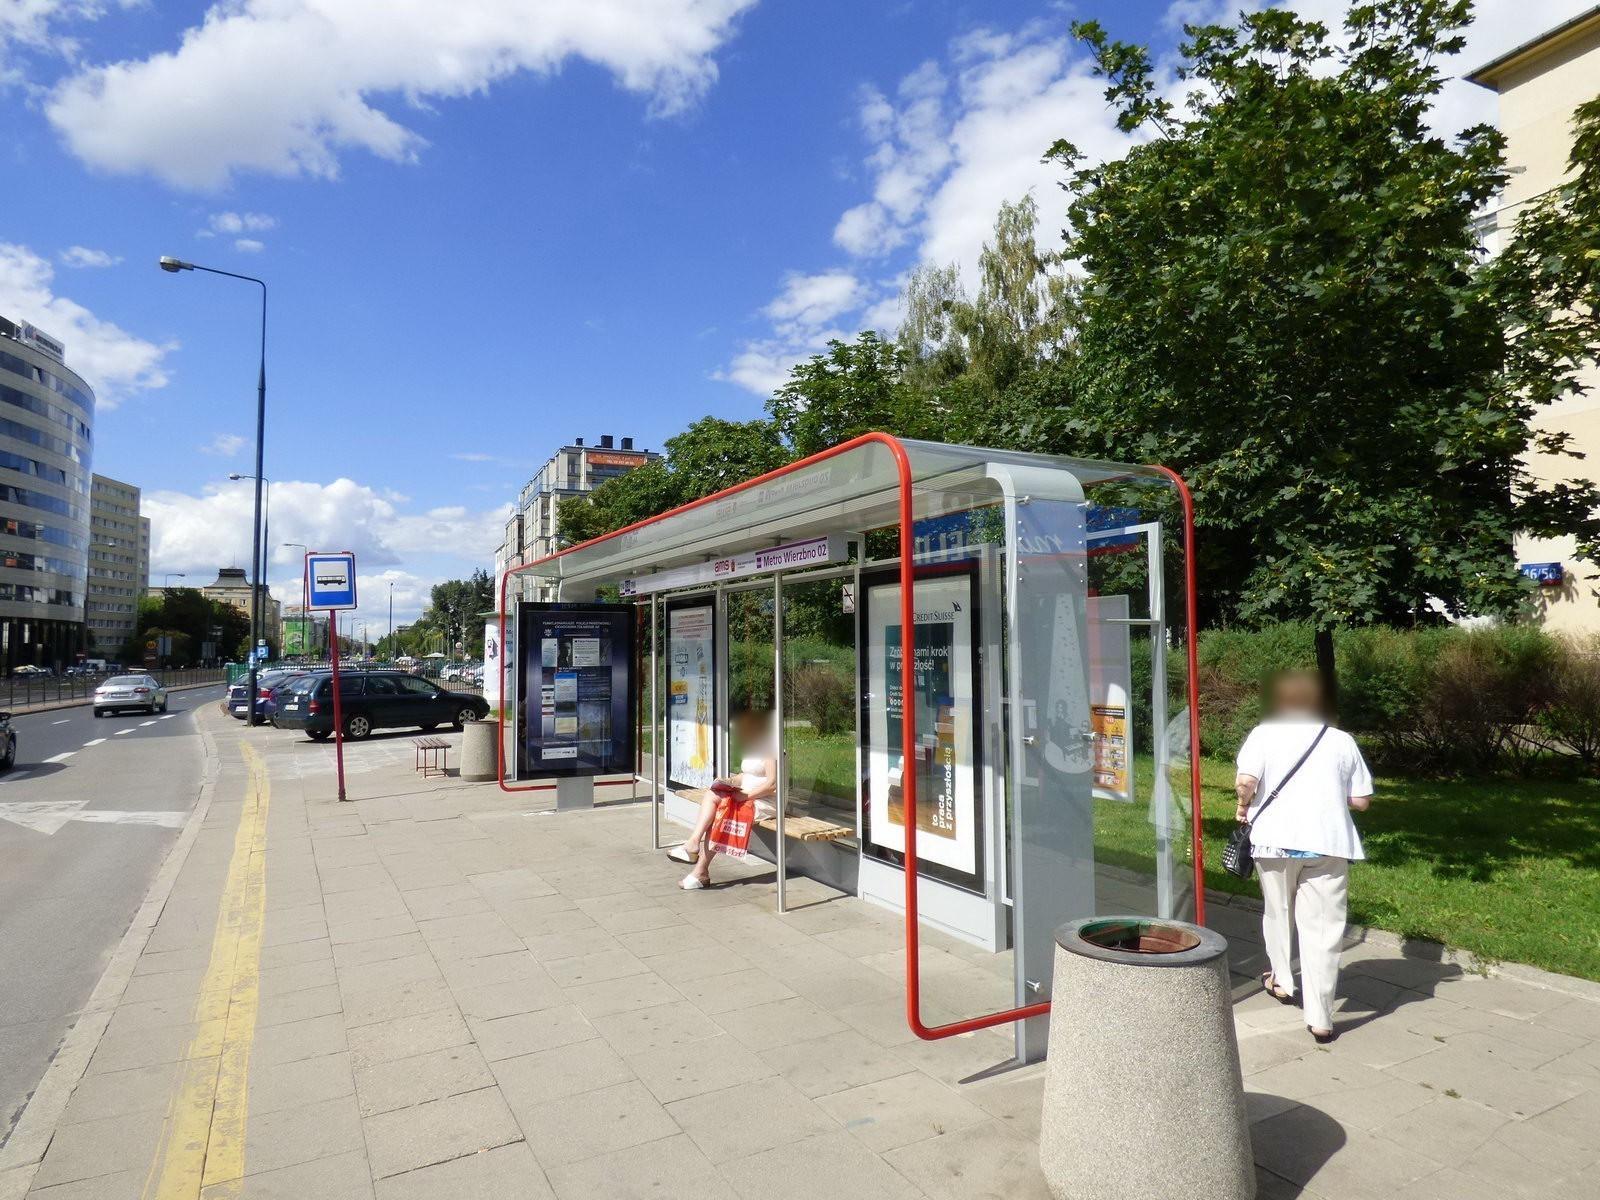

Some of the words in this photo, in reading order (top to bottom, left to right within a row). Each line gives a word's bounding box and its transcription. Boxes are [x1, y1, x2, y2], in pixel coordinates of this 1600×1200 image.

[763, 555, 783, 567] Metro
[783, 548, 817, 563] Wierzbno
[817, 544, 827, 556] 02
[931, 645, 949, 657] krok
[938, 794, 946, 829] praca
